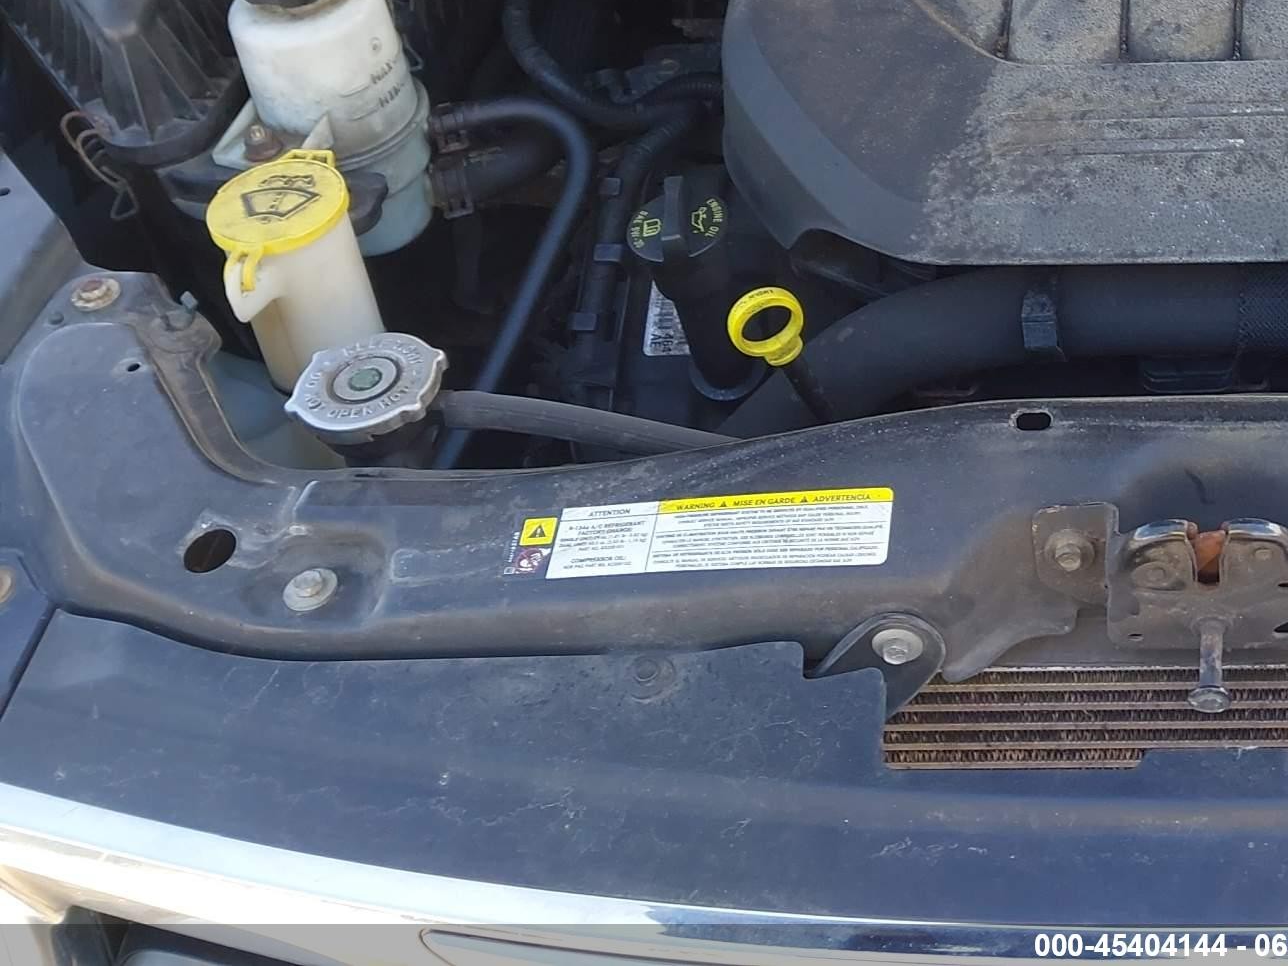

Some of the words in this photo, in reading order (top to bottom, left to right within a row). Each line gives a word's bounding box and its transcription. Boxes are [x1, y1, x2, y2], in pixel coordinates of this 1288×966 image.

[706, 198, 723, 223] ENGINE
[704, 226, 720, 238] OIL
[675, 502, 716, 511] WARNING
[733, 499, 754, 507] MISE
[767, 497, 795, 505] GARDE
[813, 493, 872, 503] ADVERTENCIA
[588, 508, 631, 517] ATTENTION
